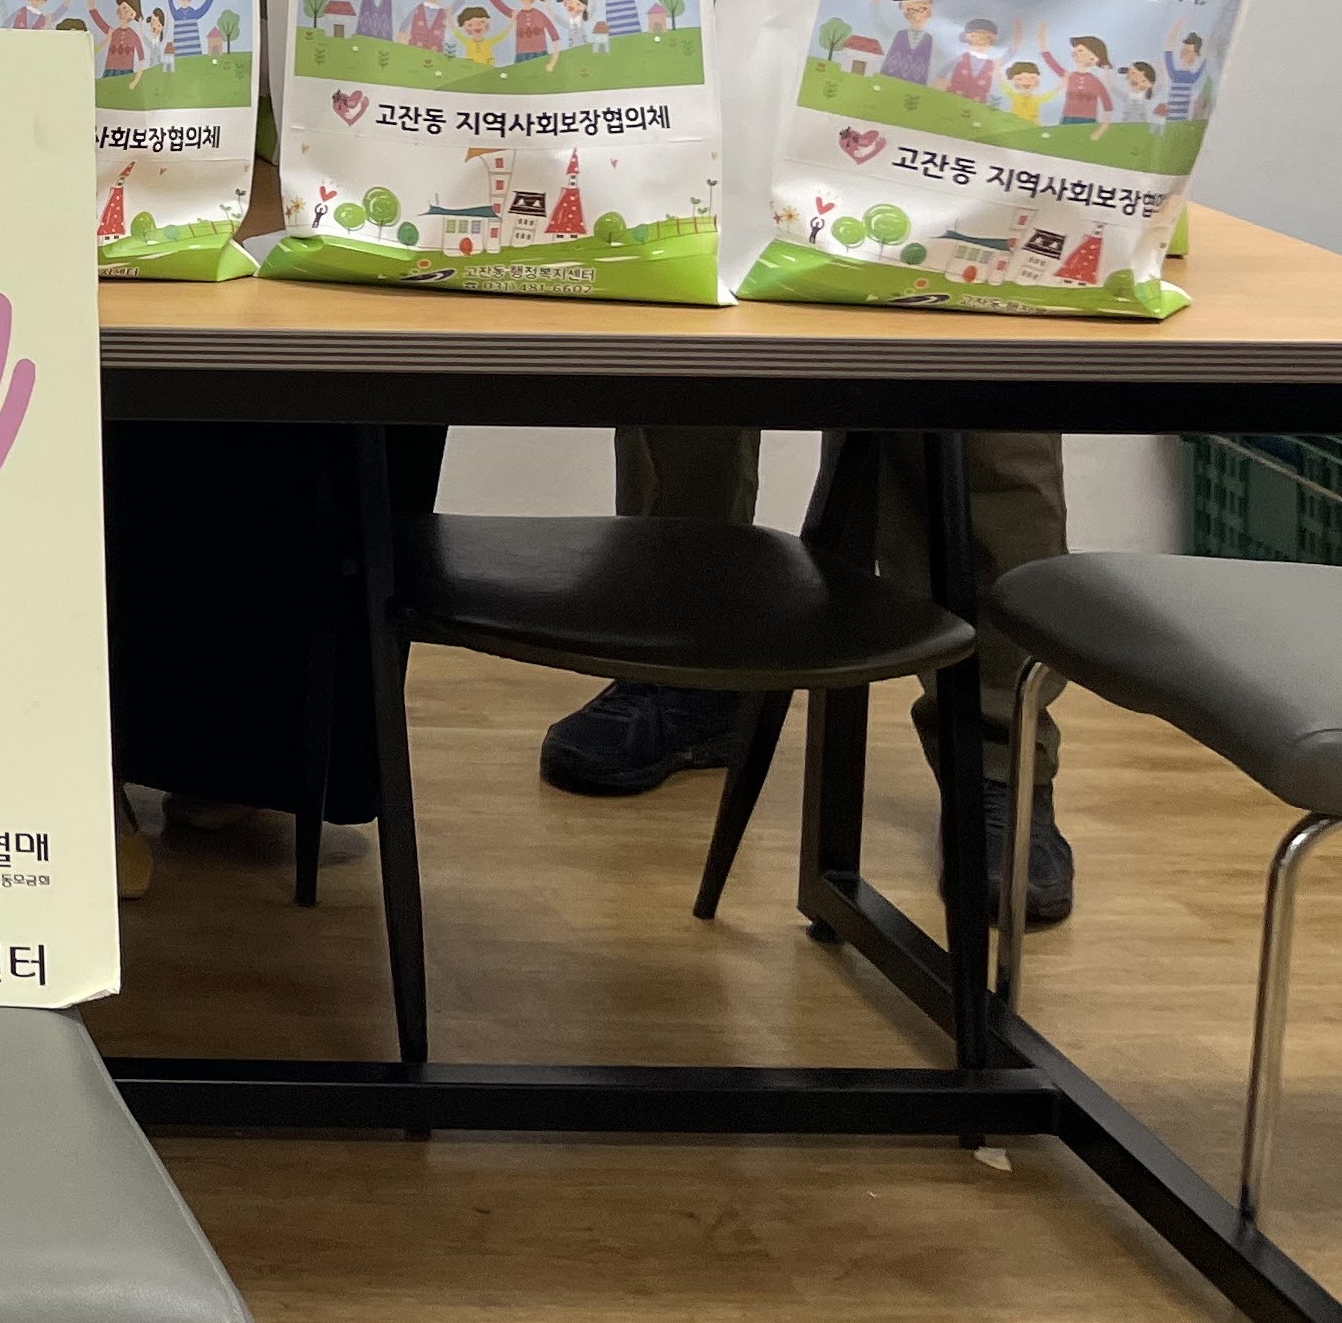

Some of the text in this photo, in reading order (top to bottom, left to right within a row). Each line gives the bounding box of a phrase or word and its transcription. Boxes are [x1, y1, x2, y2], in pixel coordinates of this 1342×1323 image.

[376, 103, 671, 138] 고잔동 지역사회보장협의체
[891, 146, 976, 185] 고잔동
[466, 266, 596, 281] 고잔동 행정복지센터
